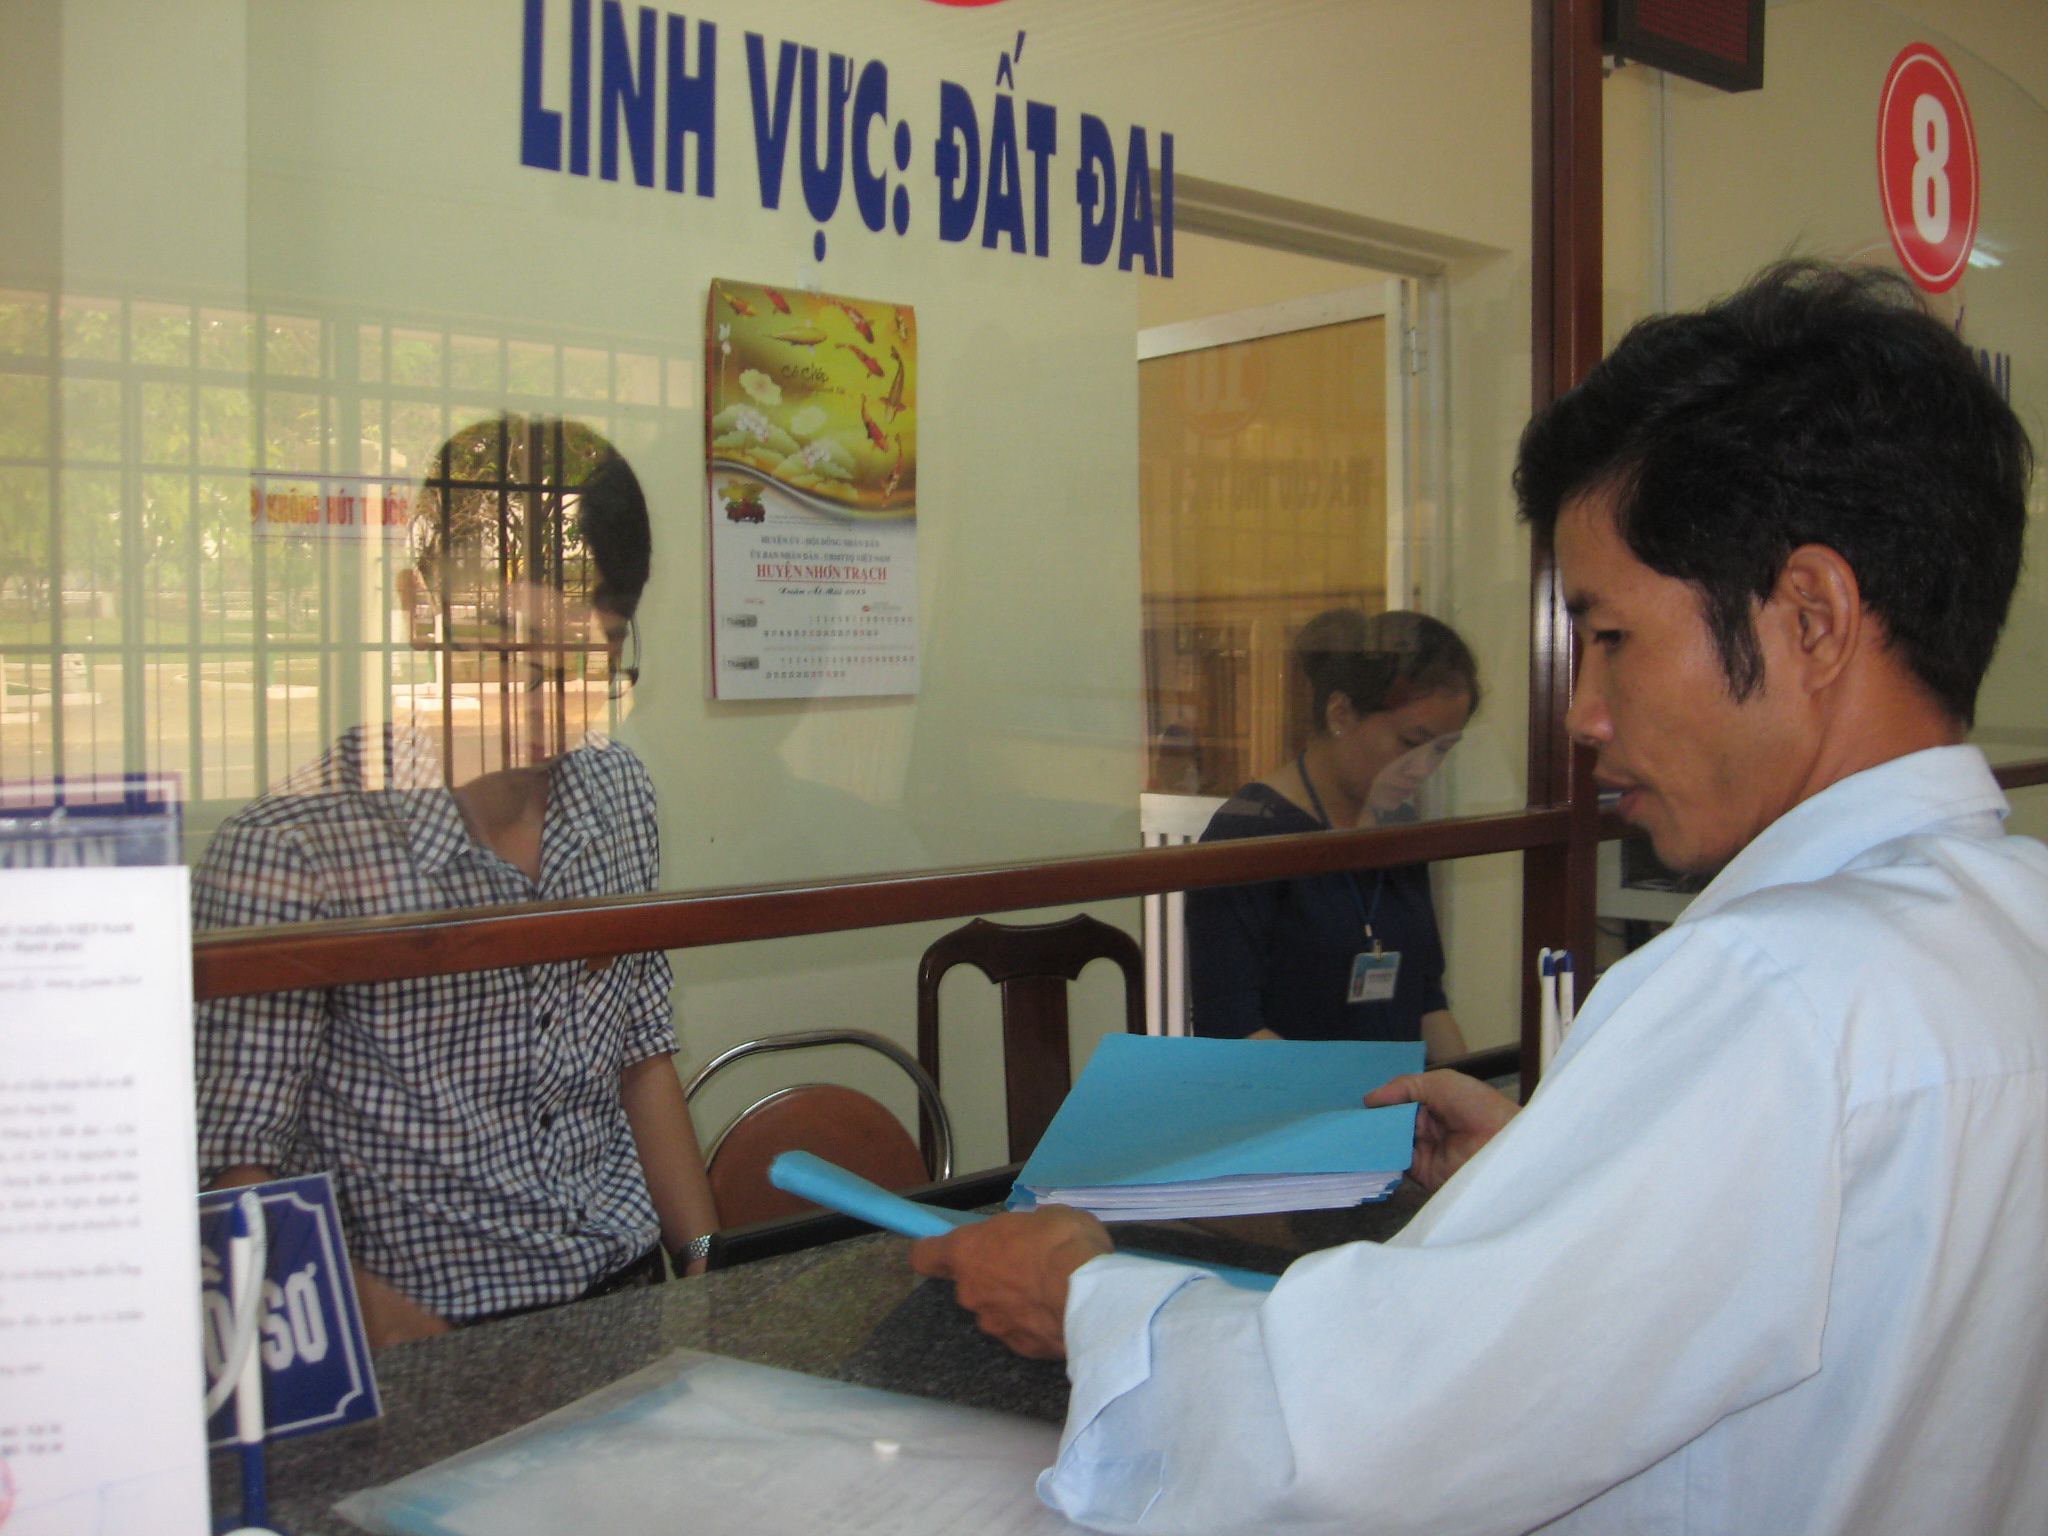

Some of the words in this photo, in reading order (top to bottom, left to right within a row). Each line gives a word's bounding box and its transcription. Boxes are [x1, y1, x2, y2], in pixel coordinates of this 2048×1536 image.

[934, 30, 1058, 259] ĐẤT
[1075, 111, 1175, 279] ĐAI
[1911, 93, 1951, 245] 8
[325, 487, 355, 526] HÚT
[361, 484, 411, 527] TUỐC
[756, 561, 803, 581] HUYỆN
[805, 564, 841, 580] NHƠN
[843, 565, 887, 582] TRẠCH
